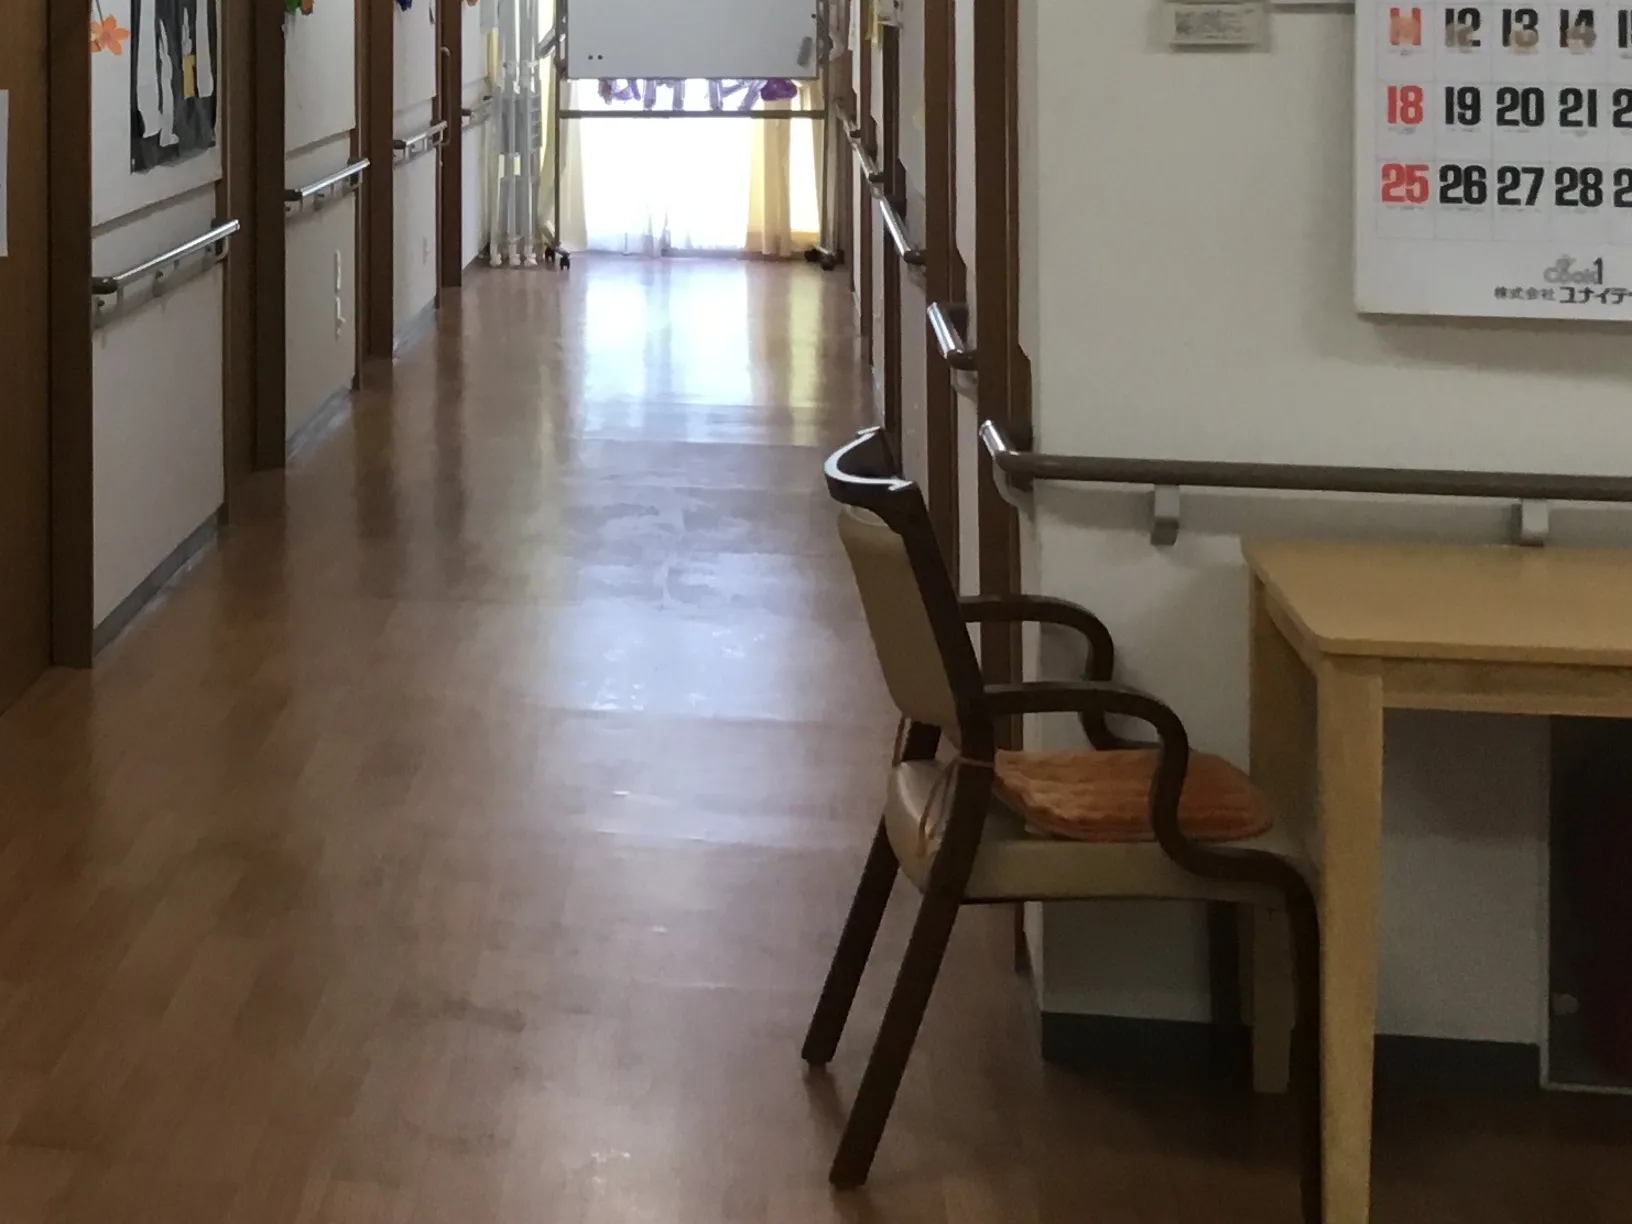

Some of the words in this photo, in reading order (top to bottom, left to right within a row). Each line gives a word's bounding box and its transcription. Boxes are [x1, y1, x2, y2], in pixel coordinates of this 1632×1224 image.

[1445, 7, 1481, 47] 12
[1502, 8, 1539, 47] 13
[1560, 8, 1595, 48] 14
[1618, 10, 1632, 48] 1
[1387, 85, 1424, 124] 18
[1445, 86, 1481, 125] 19
[1496, 86, 1545, 127] 20
[1559, 87, 1597, 128] 21
[1381, 163, 1429, 204] 25
[1439, 164, 1487, 204] 26
[1497, 166, 1545, 206] 27
[1555, 167, 1603, 207] 28
[1494, 285, 1632, 305] 株式会社ユナイテ
